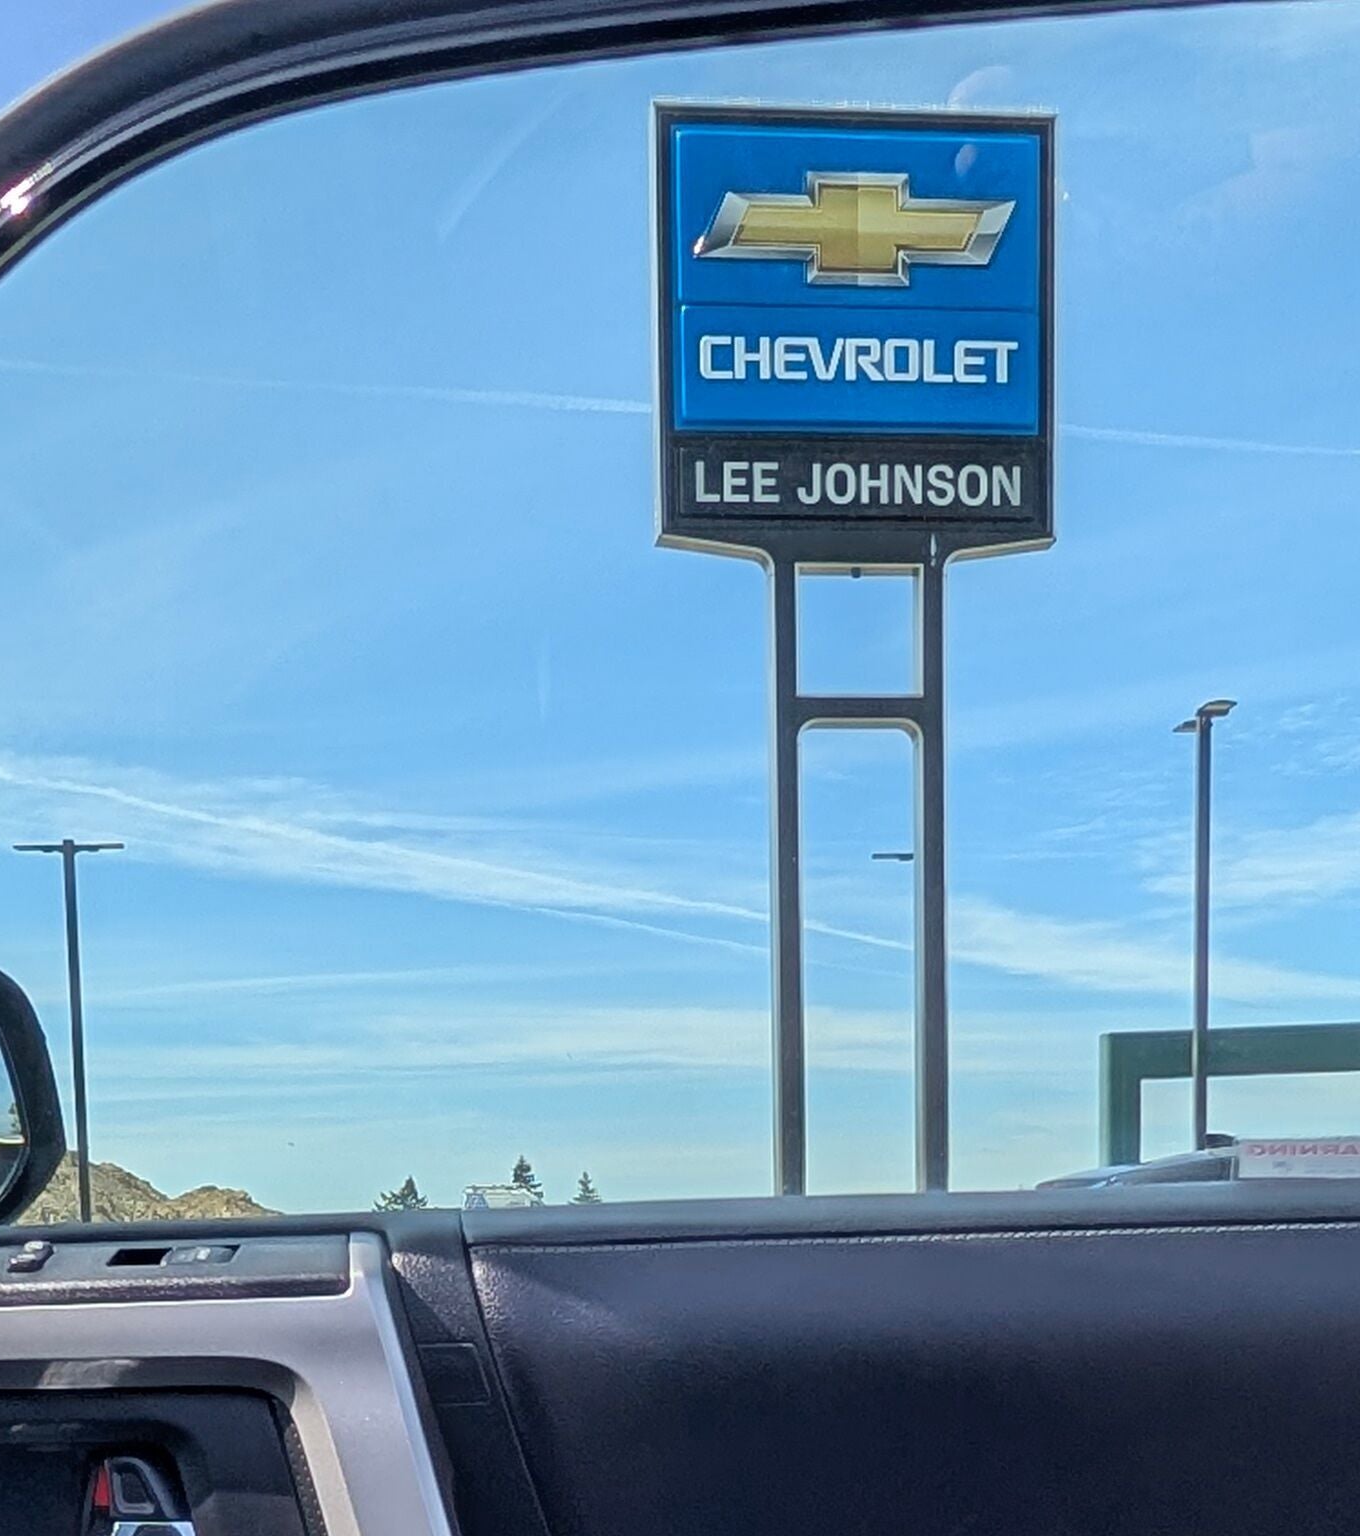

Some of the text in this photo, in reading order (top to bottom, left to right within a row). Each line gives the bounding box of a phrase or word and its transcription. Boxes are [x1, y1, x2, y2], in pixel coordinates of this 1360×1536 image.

[699, 335, 1019, 384] CHEVROLET
[694, 460, 1022, 507] LEE JOHNSON
